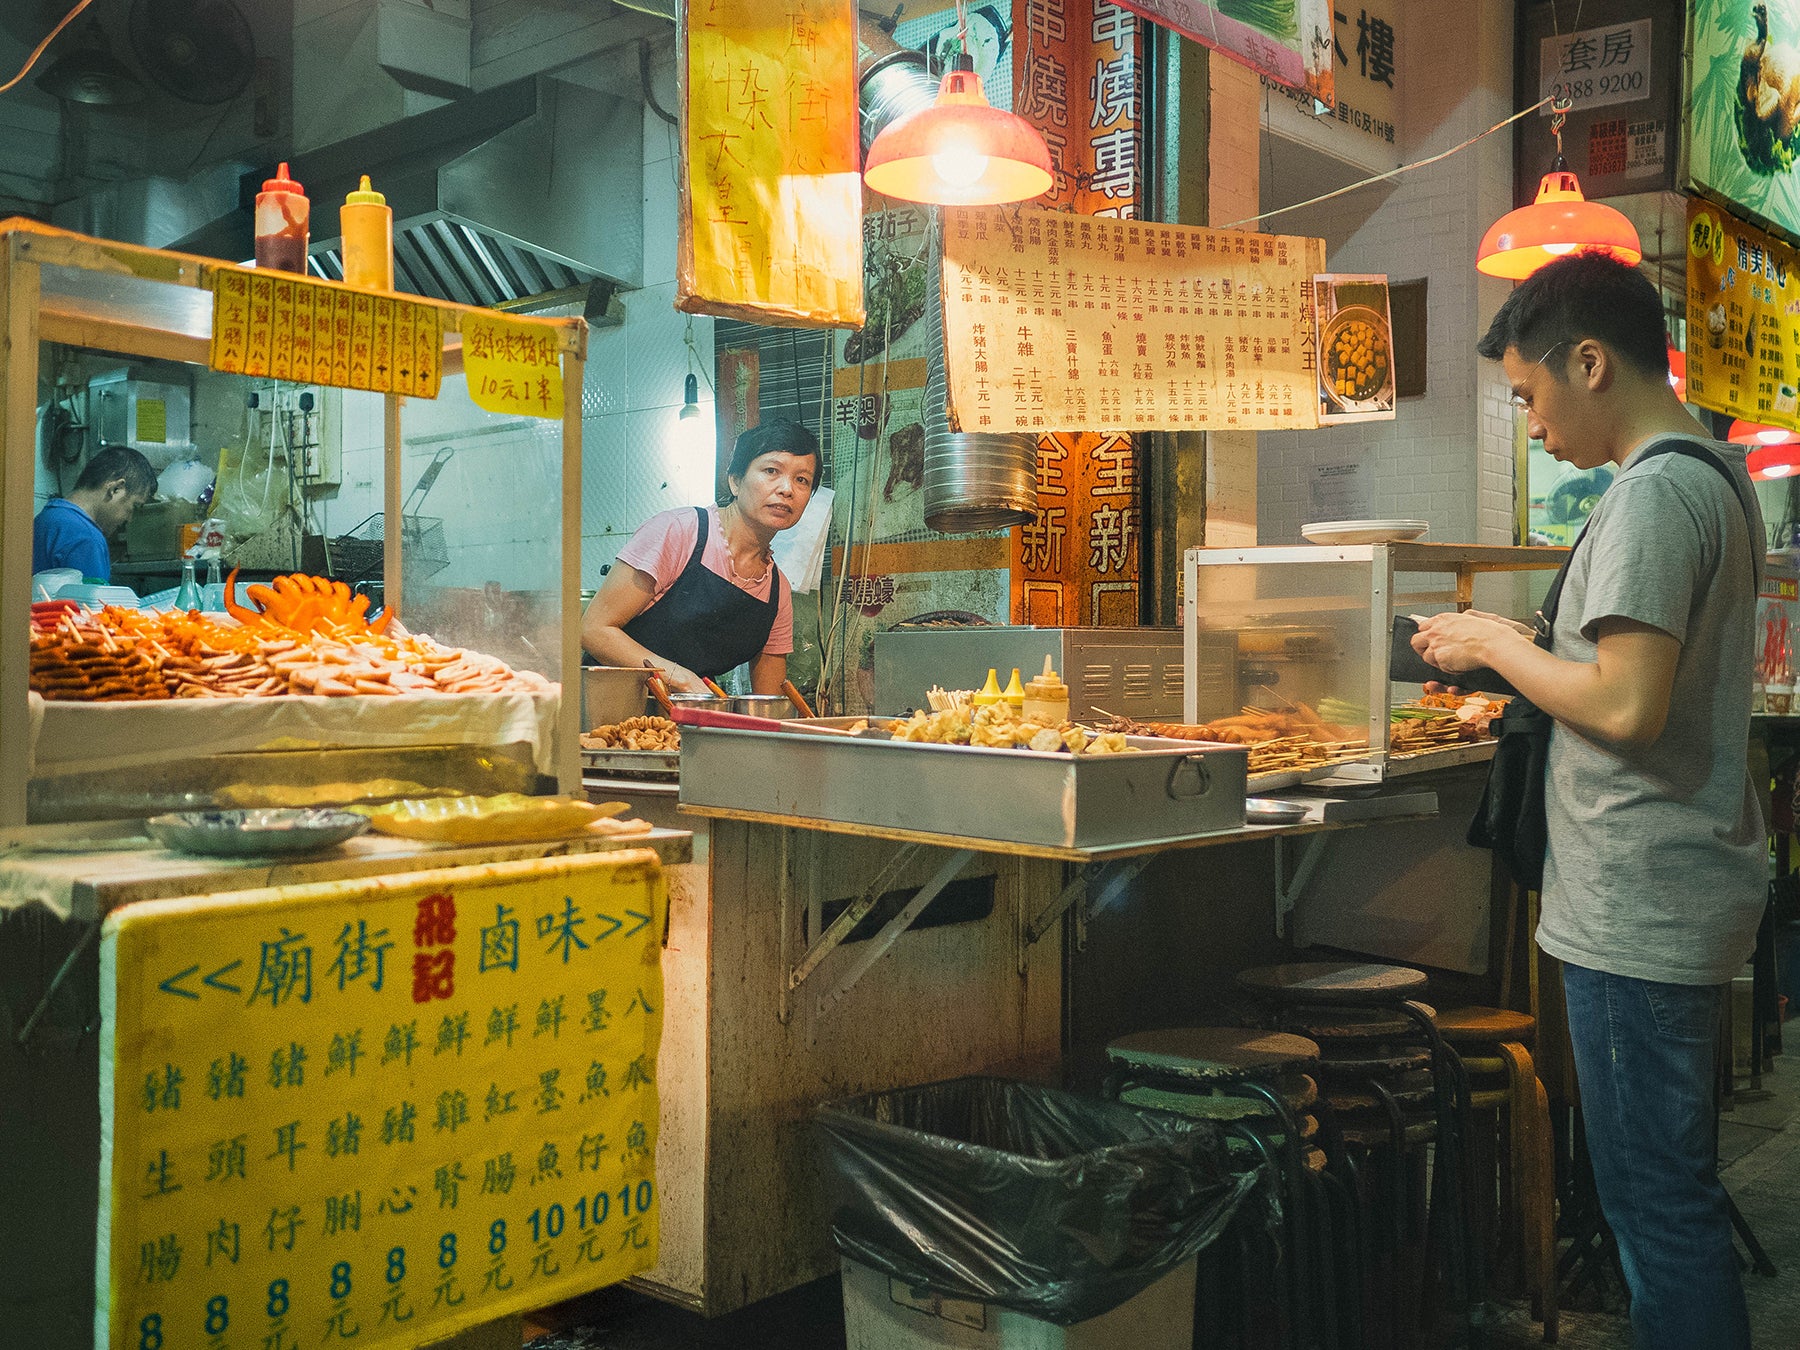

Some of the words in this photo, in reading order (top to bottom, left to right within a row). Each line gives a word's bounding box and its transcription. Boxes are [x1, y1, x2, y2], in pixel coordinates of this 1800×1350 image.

[1562, 29, 1635, 73] 套房
[1600, 71, 1643, 95] 9200
[957, 210, 969, 239] 四季豆
[1080, 222, 1092, 250] 墨魚丸
[1113, 226, 1125, 262] 司華力腸
[1175, 231, 1187, 258] 雞軟骨
[1220, 236, 1231, 253] 牛肉
[1235, 237, 1245, 255] 雞肉
[1264, 240, 1274, 257] 紅腸
[960, 264, 973, 303] 八元一串
[978, 265, 991, 303] 八元一串
[996, 267, 1009, 304] 八元一串
[1014, 268, 1027, 315] 十二元一串
[1032, 270, 1045, 316] 十二元一串
[1049, 271, 1062, 317] 十二元一串
[1083, 274, 1095, 309] 十元一串
[1099, 275, 1111, 310] 十元一串
[1115, 275, 1128, 321] 十二元一條
[1147, 278, 1158, 313] 十元一串
[1163, 279, 1174, 314] 十元一串
[1178, 278, 1189, 315] 十元一串
[1265, 286, 1276, 319] 九元一串
[1279, 287, 1289, 319] 十元一串
[972, 323, 988, 373] 炸豬大腸
[1017, 325, 1034, 357] 牛雜
[1065, 330, 1080, 380] 三寶什錦
[1101, 331, 1113, 356] 魚蛋
[1135, 333, 1147, 357] 燒賣
[1164, 333, 1176, 369] 燒秋刀魚
[1224, 336, 1235, 378] 生菜魚肉湯
[1281, 337, 1290, 354] 可樂
[1098, 359, 1107, 377] 十粒
[1110, 360, 1119, 376] 六粒
[1132, 362, 1142, 379] 九粒
[1144, 363, 1153, 379] 五粒
[836, 397, 875, 426] 羊架
[976, 377, 991, 426] 十元一串
[1012, 367, 1028, 426] 二十元一碗
[1029, 367, 1044, 426] 十二元一串
[1064, 387, 1074, 422] 十元件
[1076, 387, 1087, 422] 六元三件
[1099, 387, 1110, 422] 十元一碗
[1111, 388, 1121, 422] 六元一串
[1134, 388, 1145, 423] 十元一碗
[1145, 388, 1155, 422] 六元一串
[1168, 380, 1179, 423] 十五元一條
[1182, 380, 1193, 422] 十二元一串
[1197, 380, 1208, 423] 十二元一串
[1226, 383, 1238, 424] 十八元一碗
[1241, 383, 1251, 415] 九元一串
